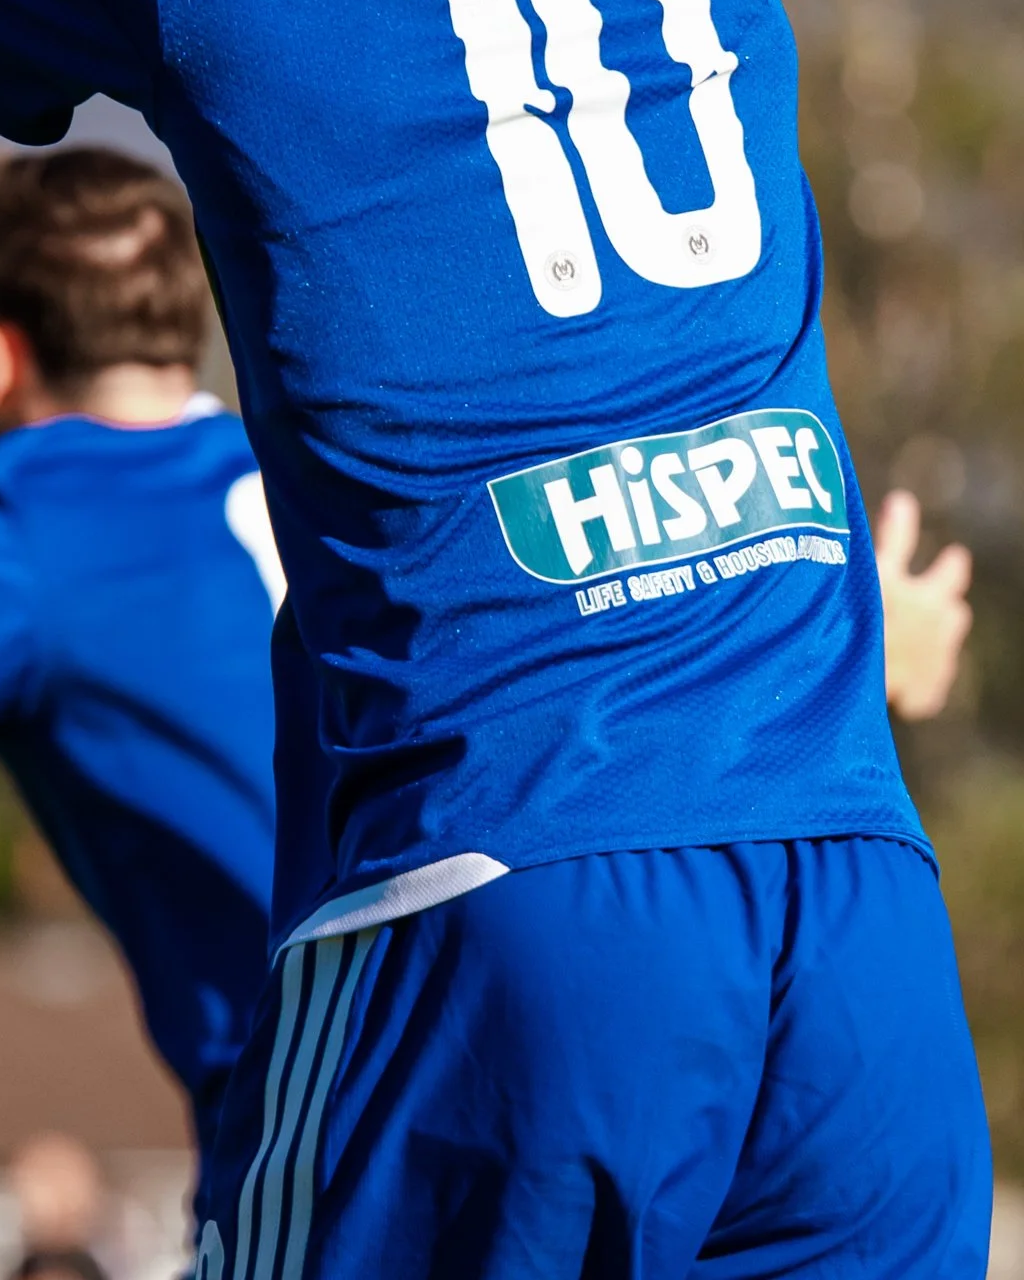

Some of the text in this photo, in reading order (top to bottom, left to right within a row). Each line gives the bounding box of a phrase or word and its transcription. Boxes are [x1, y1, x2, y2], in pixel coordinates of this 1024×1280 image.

[576, 579, 628, 616] LIFE
[627, 565, 697, 601] SAFETY
[696, 560, 718, 584] &
[713, 535, 797, 580] HOUSING
